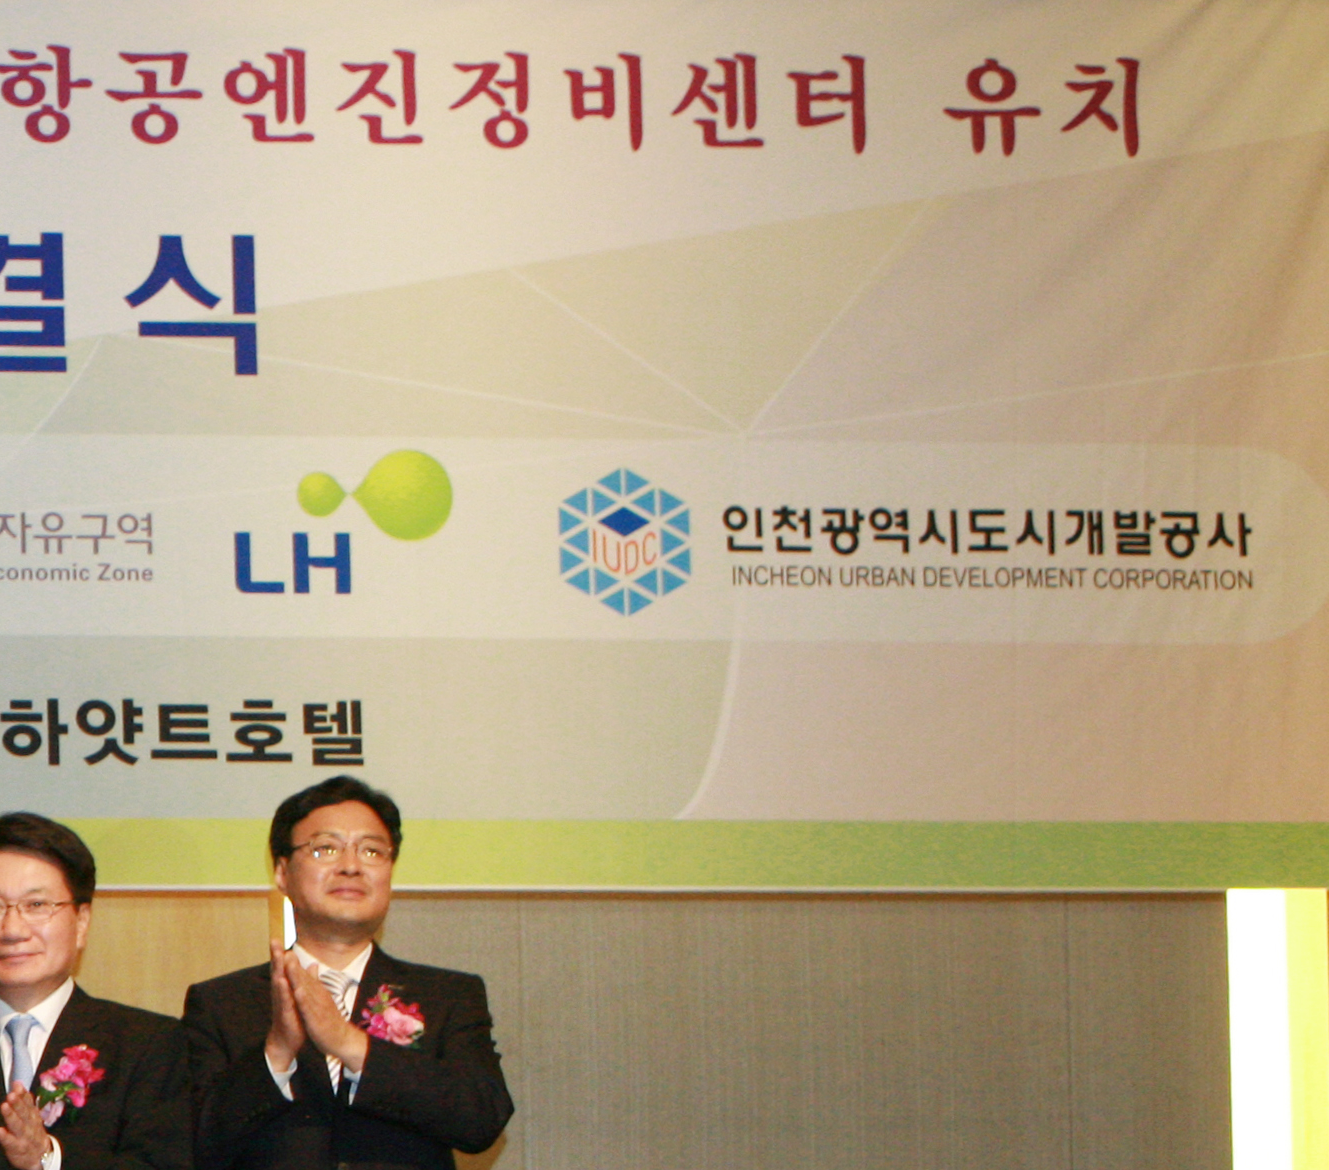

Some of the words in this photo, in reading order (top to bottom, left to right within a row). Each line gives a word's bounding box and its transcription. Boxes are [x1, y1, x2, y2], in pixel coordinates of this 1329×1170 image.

[943, 57, 1141, 158] 유치
[722, 505, 1253, 558] 인천광역시도시개발공사
[98, 563, 153, 581] Zone
[234, 531, 352, 595] LH
[732, 566, 832, 586] INCHEON
[839, 566, 915, 587] URBAN
[923, 566, 1087, 589] DEVELOPMENT
[1093, 568, 1253, 590] CORPORATION
